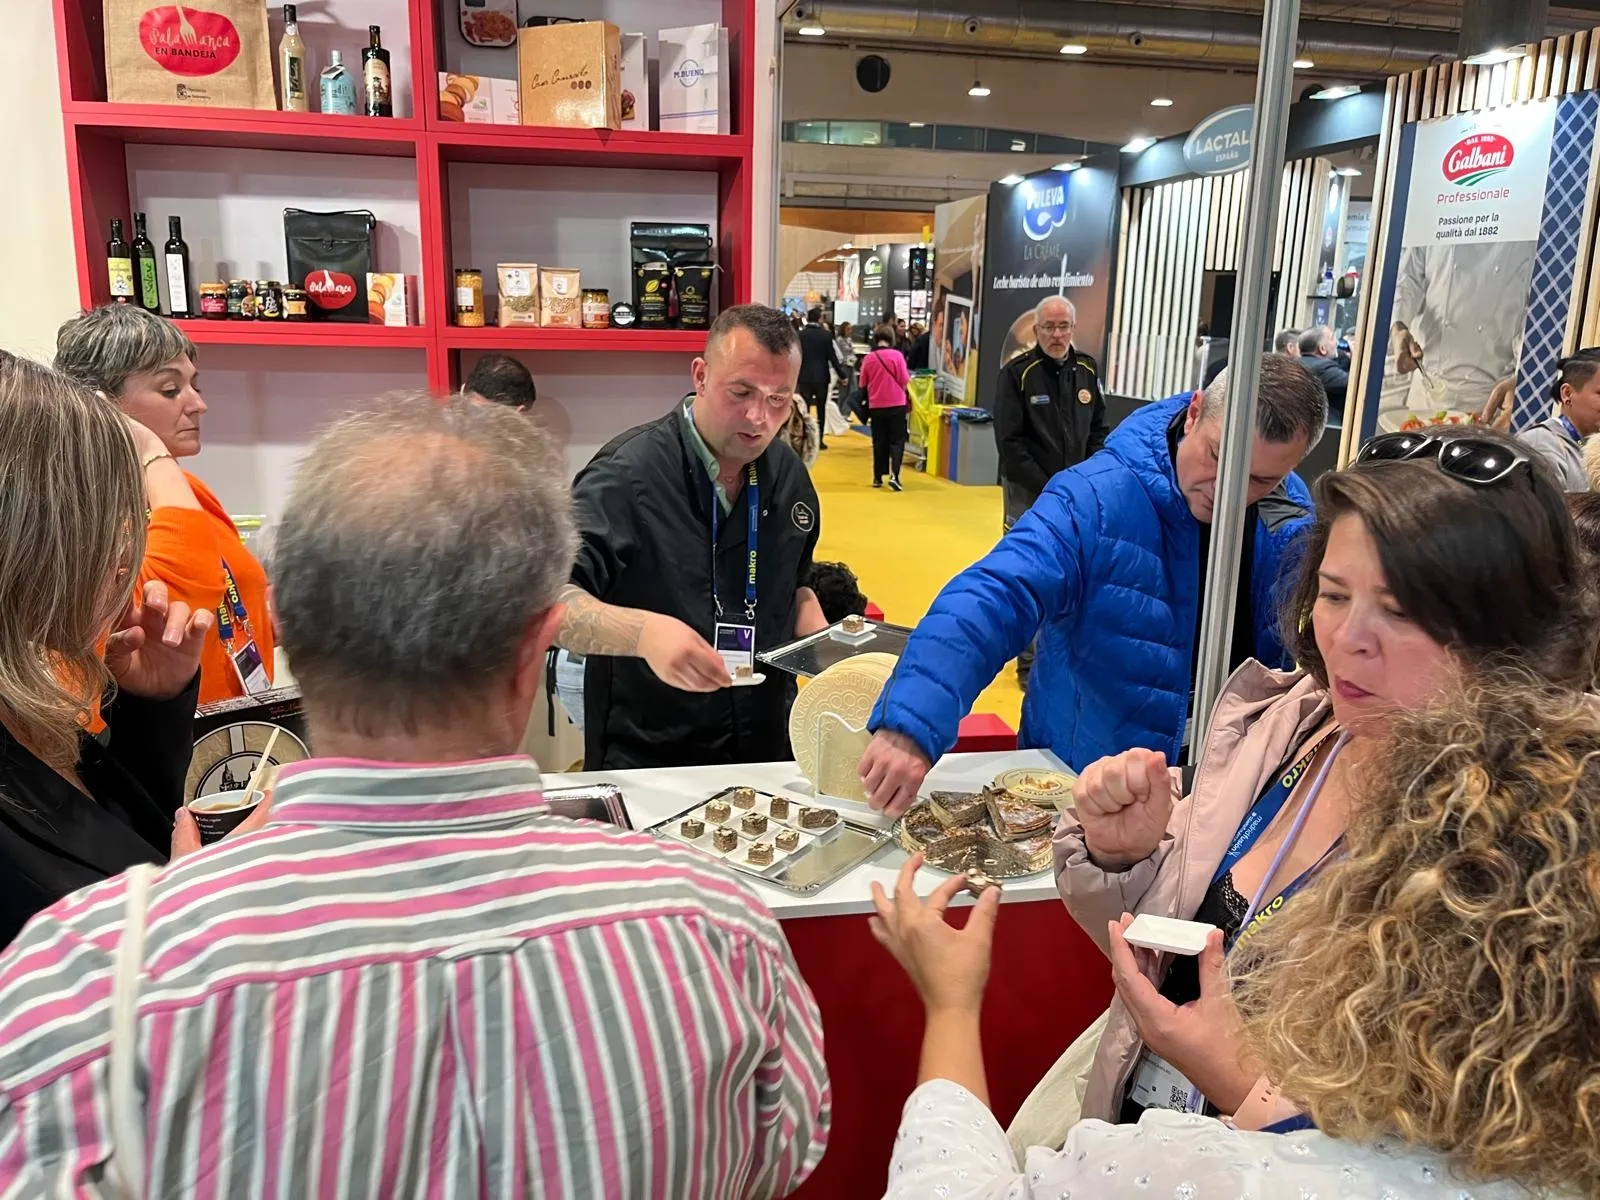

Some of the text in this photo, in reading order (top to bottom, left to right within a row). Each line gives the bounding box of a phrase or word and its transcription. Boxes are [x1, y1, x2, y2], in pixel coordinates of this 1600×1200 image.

[155, 47, 217, 59] EN BANDEJA
[1195, 129, 1249, 155] LACTAL
[1448, 144, 1507, 174] Galbani
[1437, 187, 1510, 205] Professionale
[1438, 212, 1500, 226] Passione per la
[1436, 226, 1499, 241] qualità dal 1882
[993, 275, 1009, 289] Leche
[1030, 273, 1039, 288] de
[749, 550, 757, 585] makro
[743, 629, 751, 639] V
